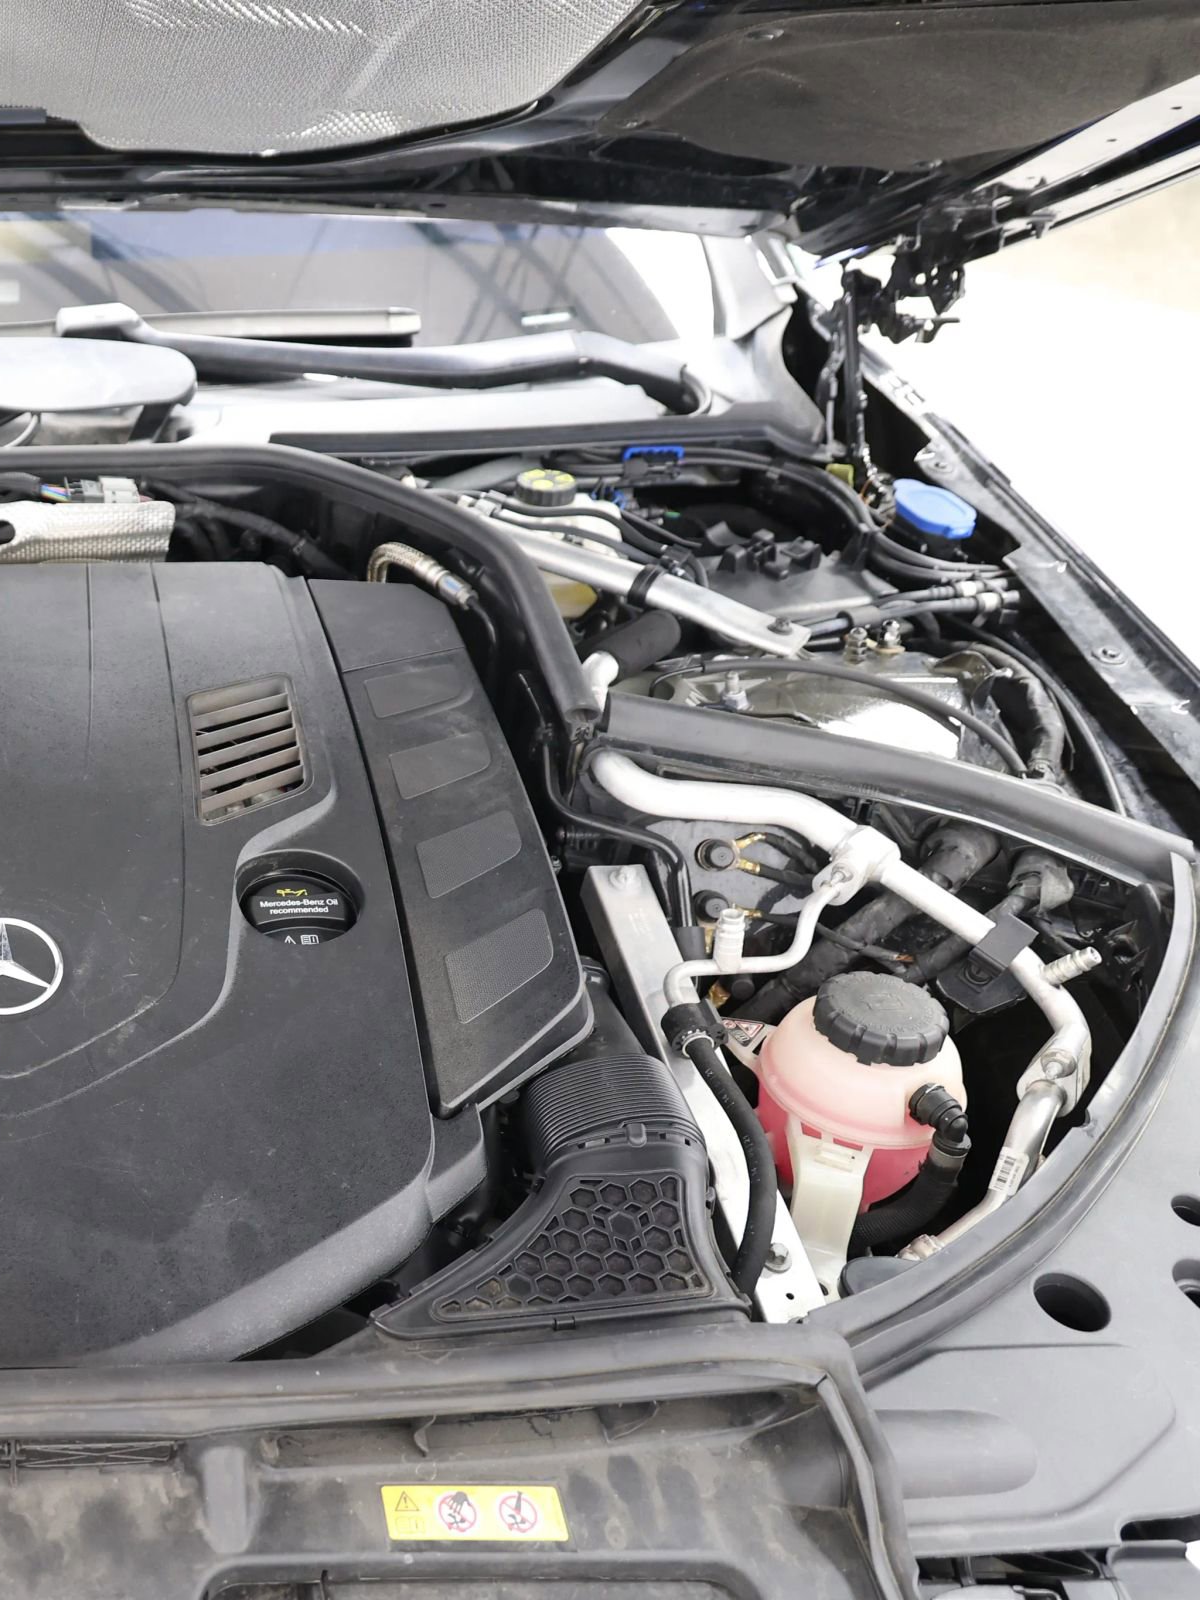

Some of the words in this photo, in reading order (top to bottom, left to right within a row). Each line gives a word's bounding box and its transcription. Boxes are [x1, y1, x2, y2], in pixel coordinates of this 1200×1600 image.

[260, 899, 325, 908] Mercedes-Benz
[326, 898, 339, 906] Oil
[269, 906, 329, 915] recommended
